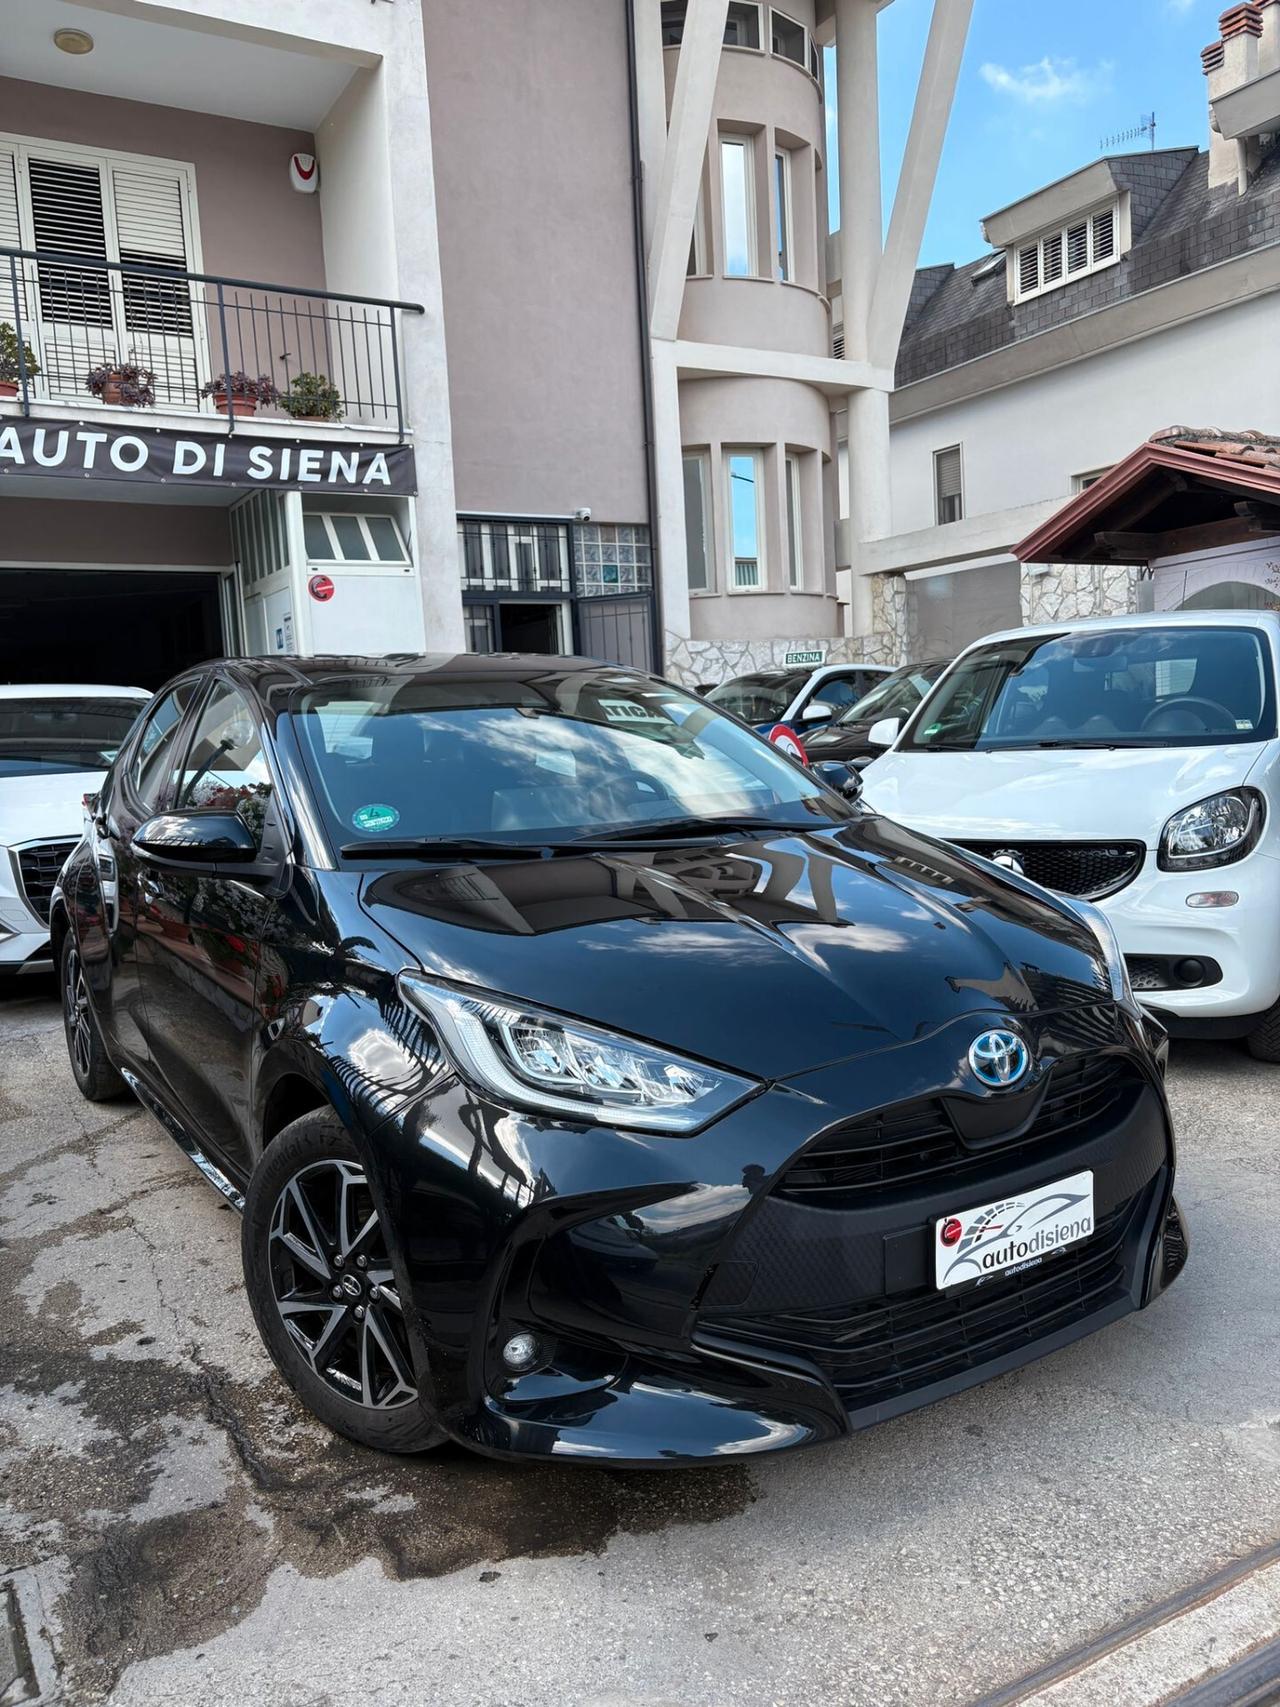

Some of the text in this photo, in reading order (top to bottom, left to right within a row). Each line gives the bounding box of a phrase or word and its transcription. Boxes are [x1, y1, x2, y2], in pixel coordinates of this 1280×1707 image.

[0, 425, 392, 486] AUTO DI SIENA
[787, 652, 821, 663] BENZINA
[982, 1217, 1092, 1270] autodisiena
[1004, 1257, 1043, 1277] autodisiena
